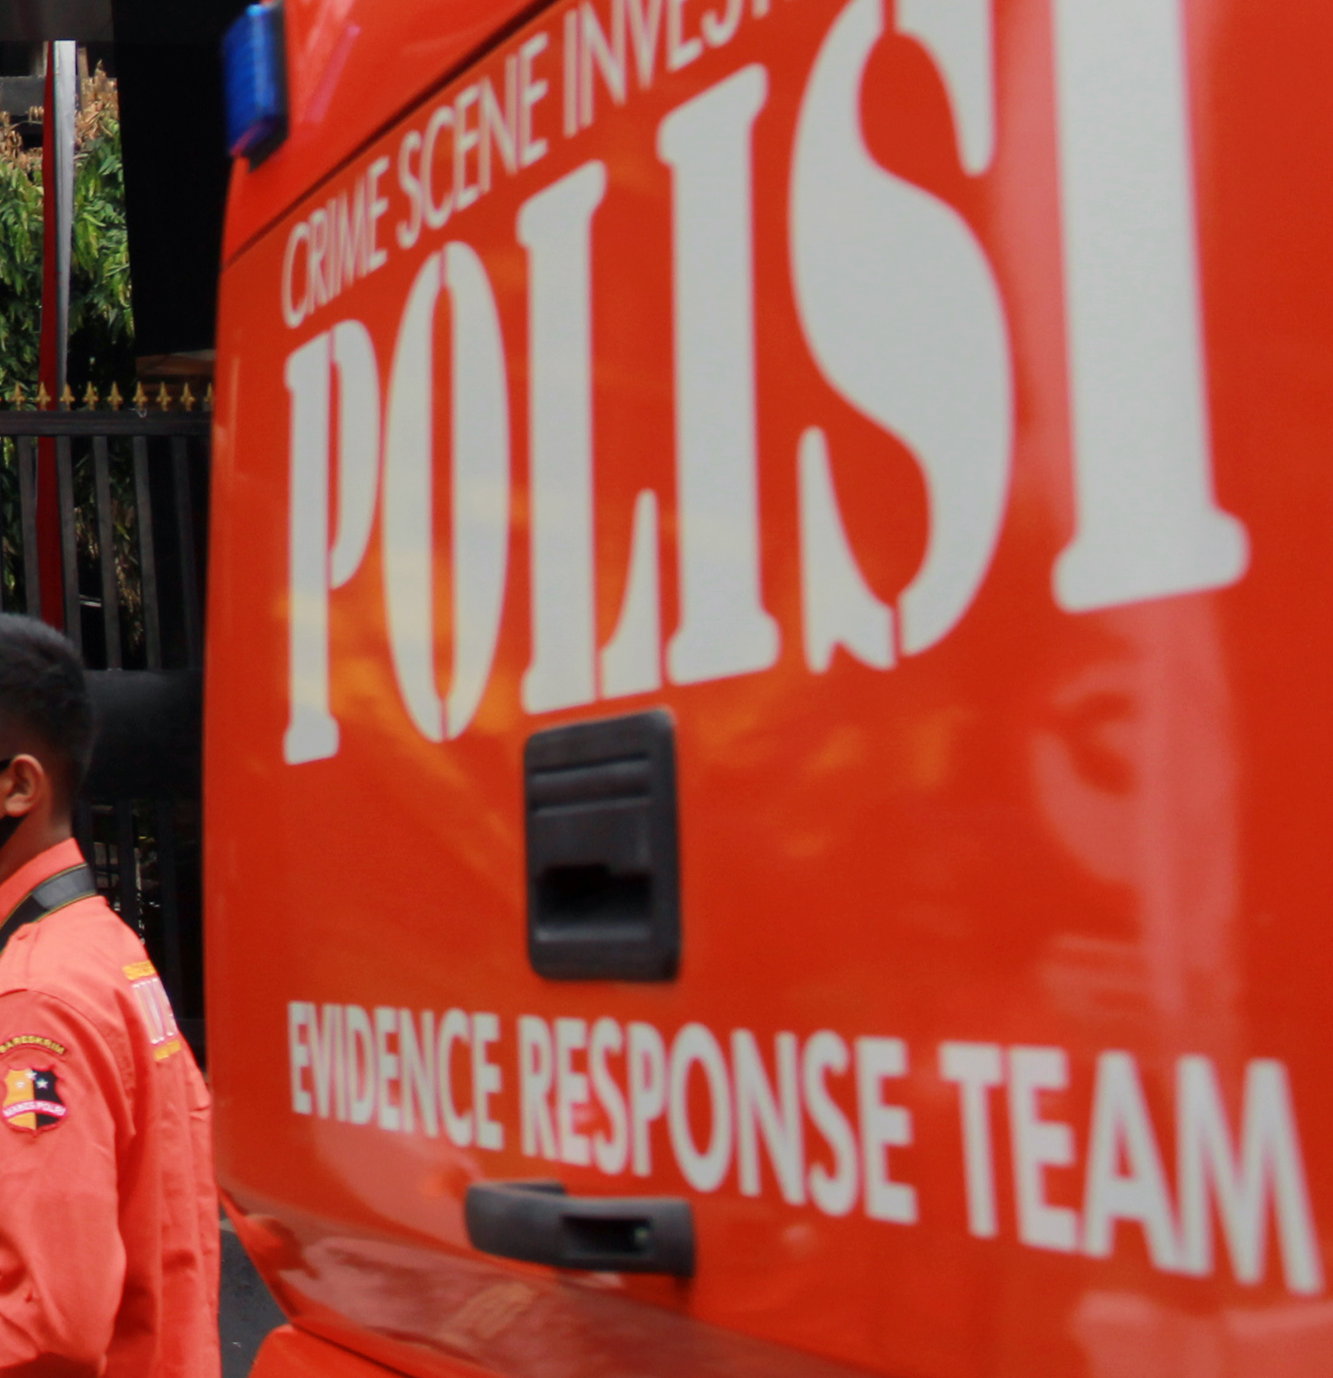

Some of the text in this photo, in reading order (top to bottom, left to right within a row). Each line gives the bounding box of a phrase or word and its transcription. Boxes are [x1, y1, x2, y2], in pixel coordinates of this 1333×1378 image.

[282, 152, 388, 329] CRIME
[397, 31, 548, 248] SCENE
[286, 1000, 1324, 1295] EVIDENCE RESPONSE TEAM
